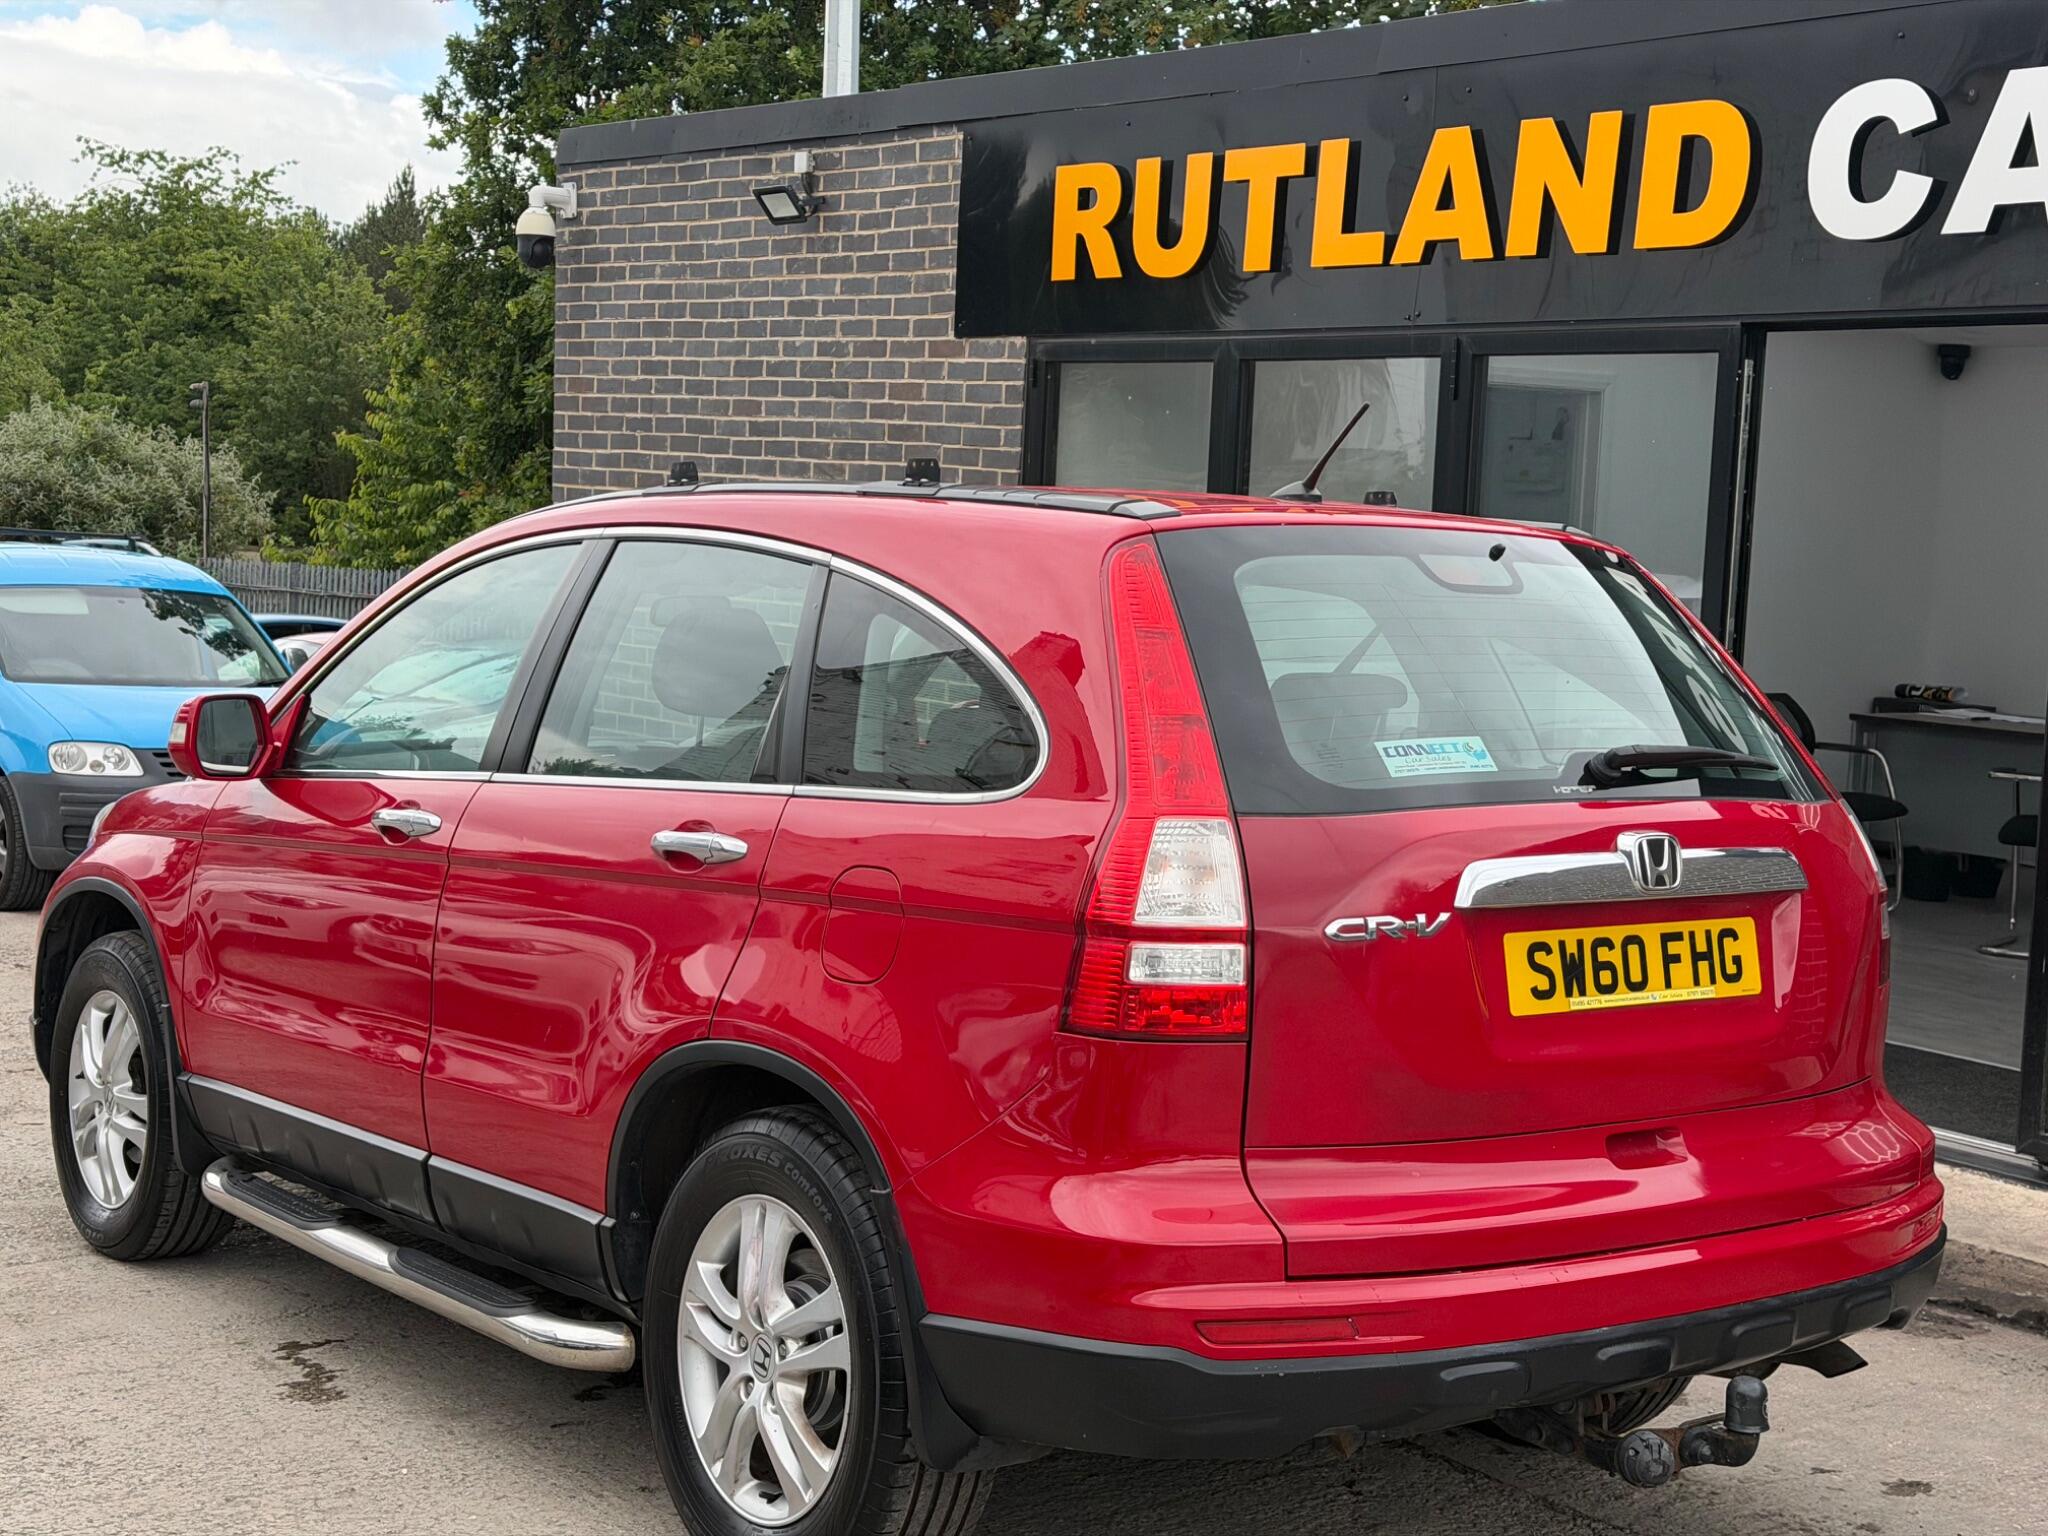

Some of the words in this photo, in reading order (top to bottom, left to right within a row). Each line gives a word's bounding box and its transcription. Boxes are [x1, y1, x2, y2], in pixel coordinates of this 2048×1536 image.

[1051, 98, 1751, 282] RUTLAND
[1324, 912, 1452, 942] CR-V
[1526, 934, 1650, 1001] SW60
[1659, 927, 1743, 990] FHG
